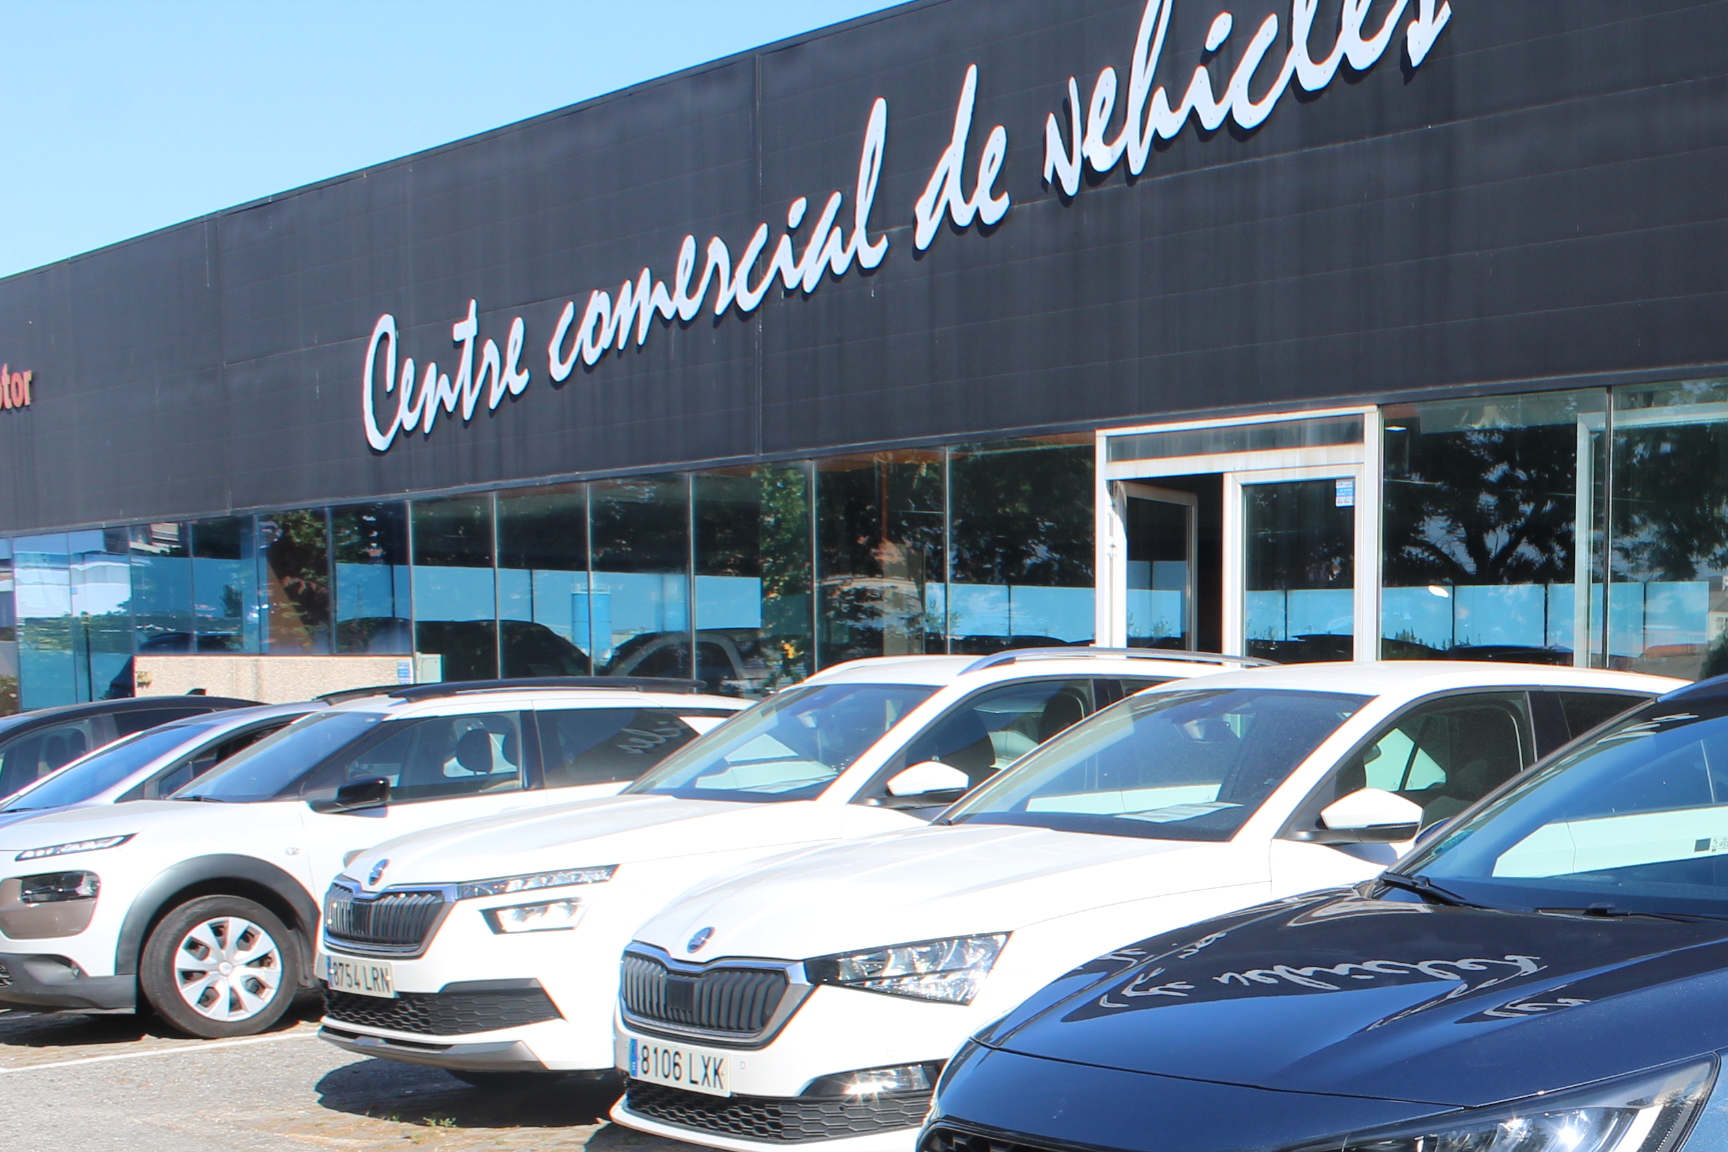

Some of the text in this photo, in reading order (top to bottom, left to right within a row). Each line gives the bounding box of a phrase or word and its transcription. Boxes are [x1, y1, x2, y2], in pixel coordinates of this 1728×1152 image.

[363, 299, 530, 451] Centre
[548, 97, 889, 381] comercial
[914, 63, 1010, 250] de
[0, 363, 32, 410] tor
[333, 961, 391, 993] 8754 LRN
[641, 1044, 724, 1090] 8106 LXK
